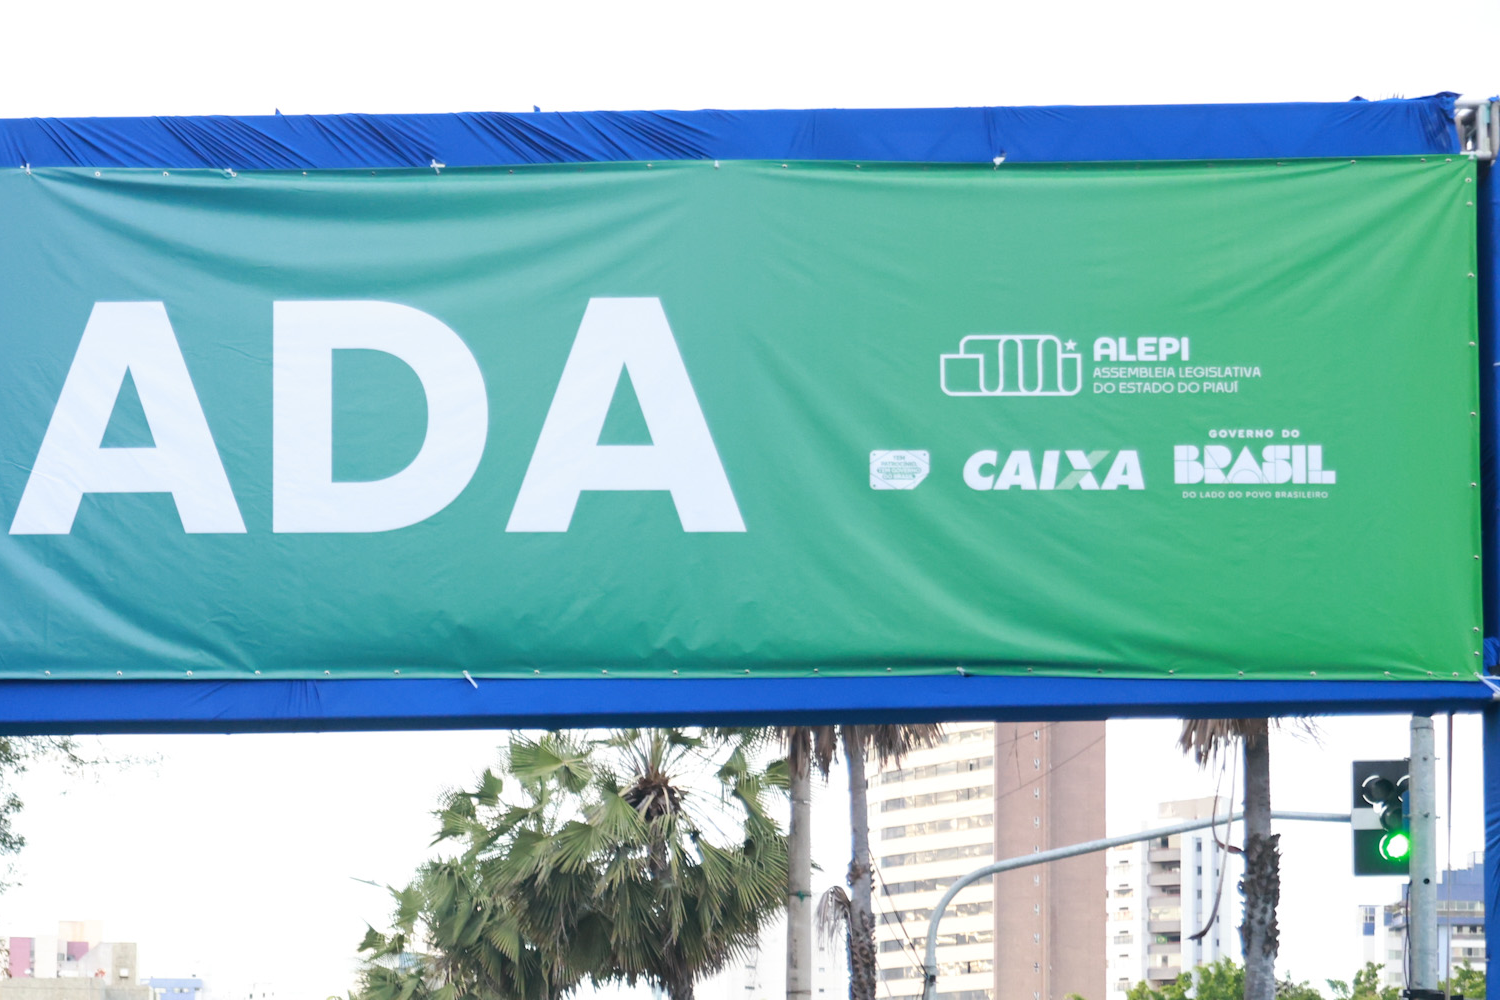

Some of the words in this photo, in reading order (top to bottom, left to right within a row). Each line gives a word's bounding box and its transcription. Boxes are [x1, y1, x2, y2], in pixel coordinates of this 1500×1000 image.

[1093, 337, 1189, 361] ALEPI
[1093, 367, 1175, 378] ASSEMBLEIA
[1179, 366, 1262, 378] LEGISLATIVA
[1093, 382, 1116, 394] DO
[1119, 382, 1174, 393] ESTADO
[1178, 382, 1200, 393] DO
[1203, 380, 1239, 393] PIAUÍ
[1208, 429, 1274, 438] GOVERNO
[1281, 429, 1300, 438] DO
[963, 450, 1145, 490] CAIXA
[1174, 445, 1336, 484] BRASIL
